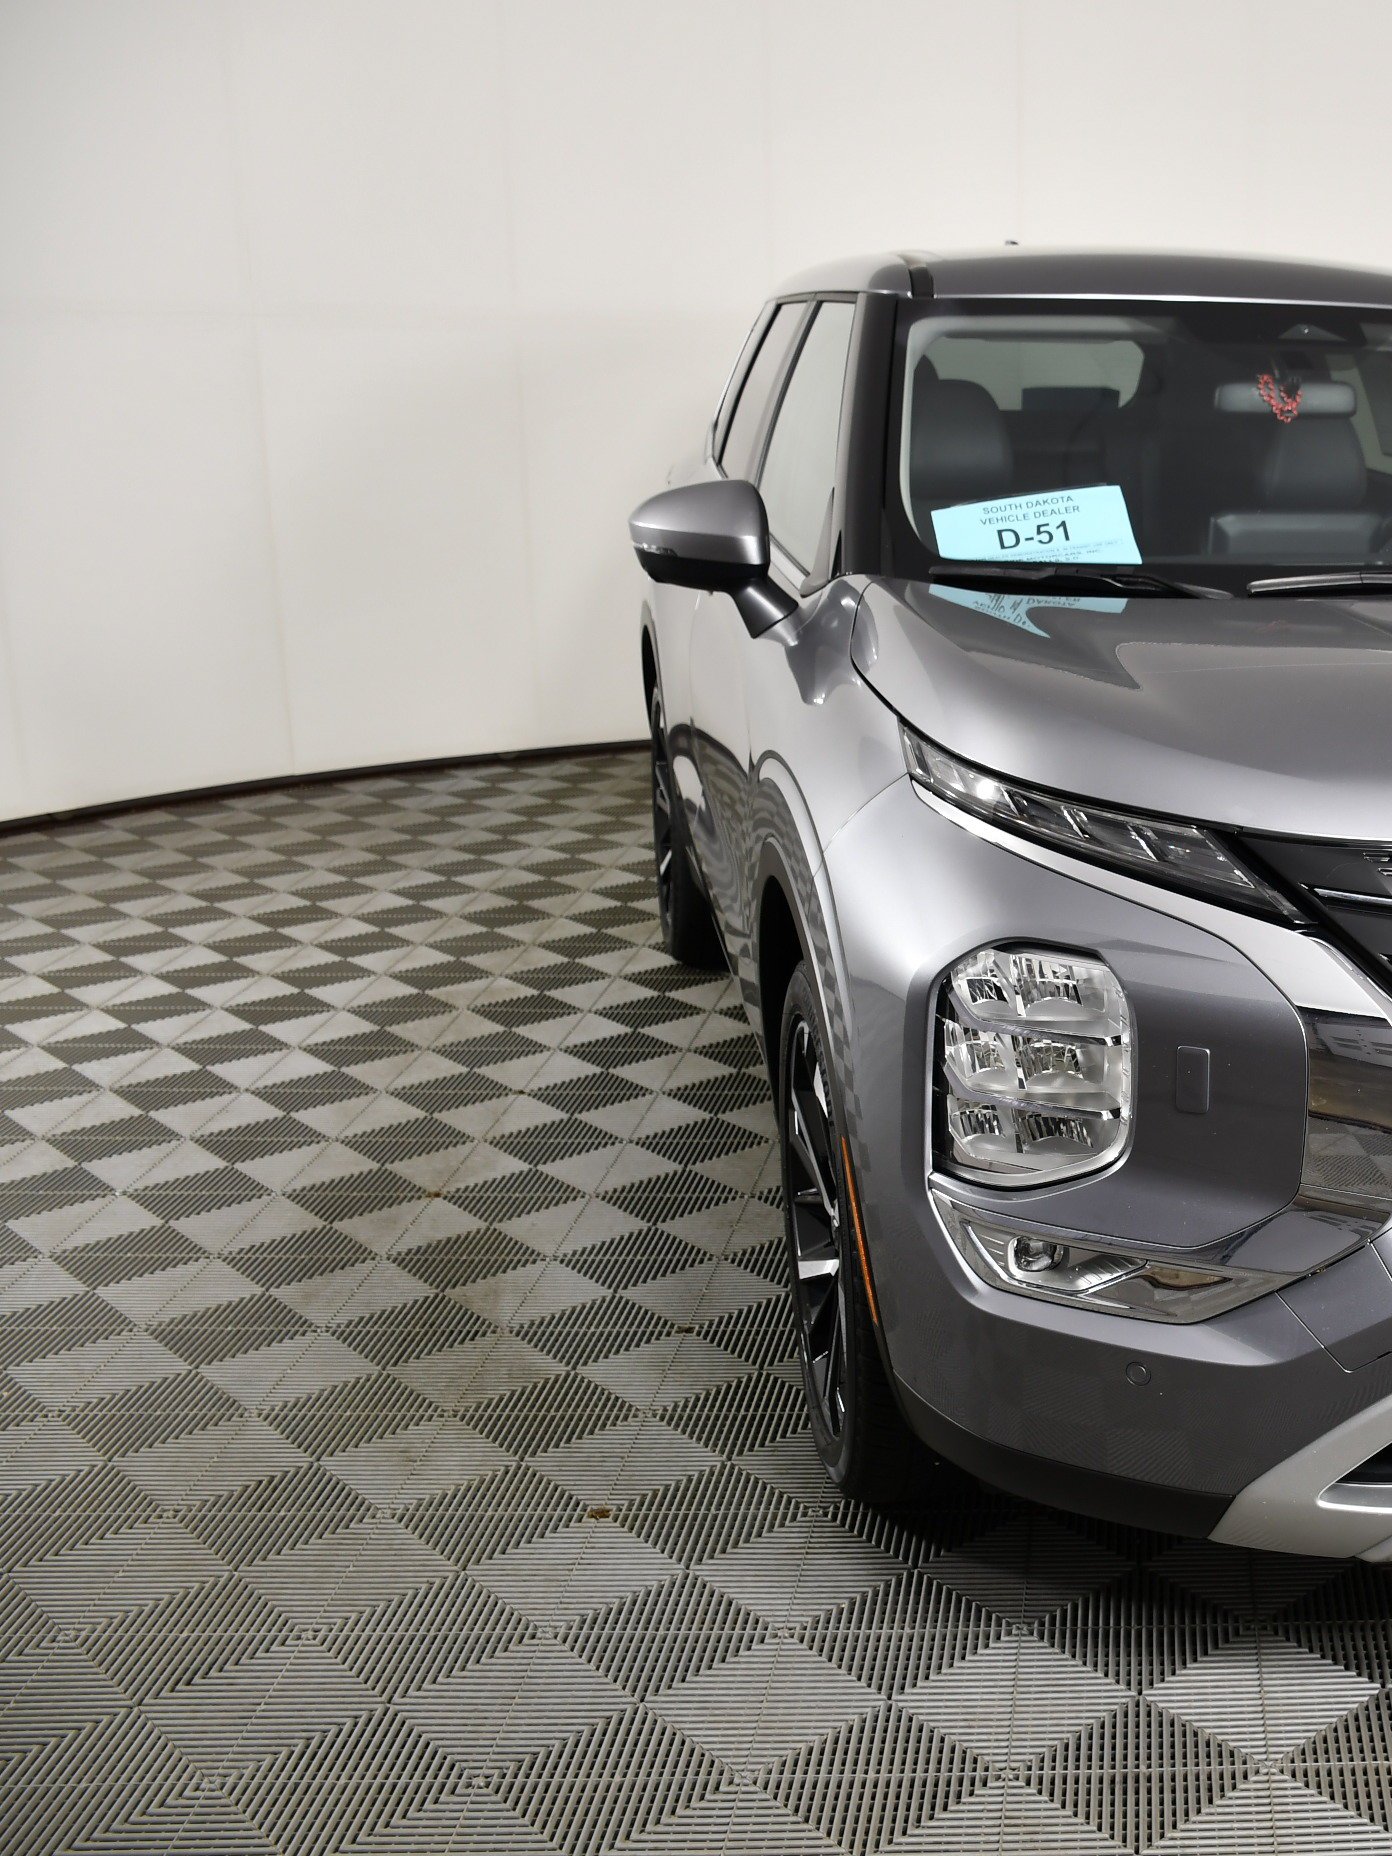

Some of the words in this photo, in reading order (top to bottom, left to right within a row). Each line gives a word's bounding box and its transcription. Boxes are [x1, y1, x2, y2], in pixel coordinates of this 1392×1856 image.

[982, 503, 1022, 514] SOUTH
[1026, 495, 1074, 509] DAKOTA
[980, 513, 1030, 525] VEHICLE
[1033, 505, 1080, 519] DEALER
[997, 520, 1070, 550] D-51
